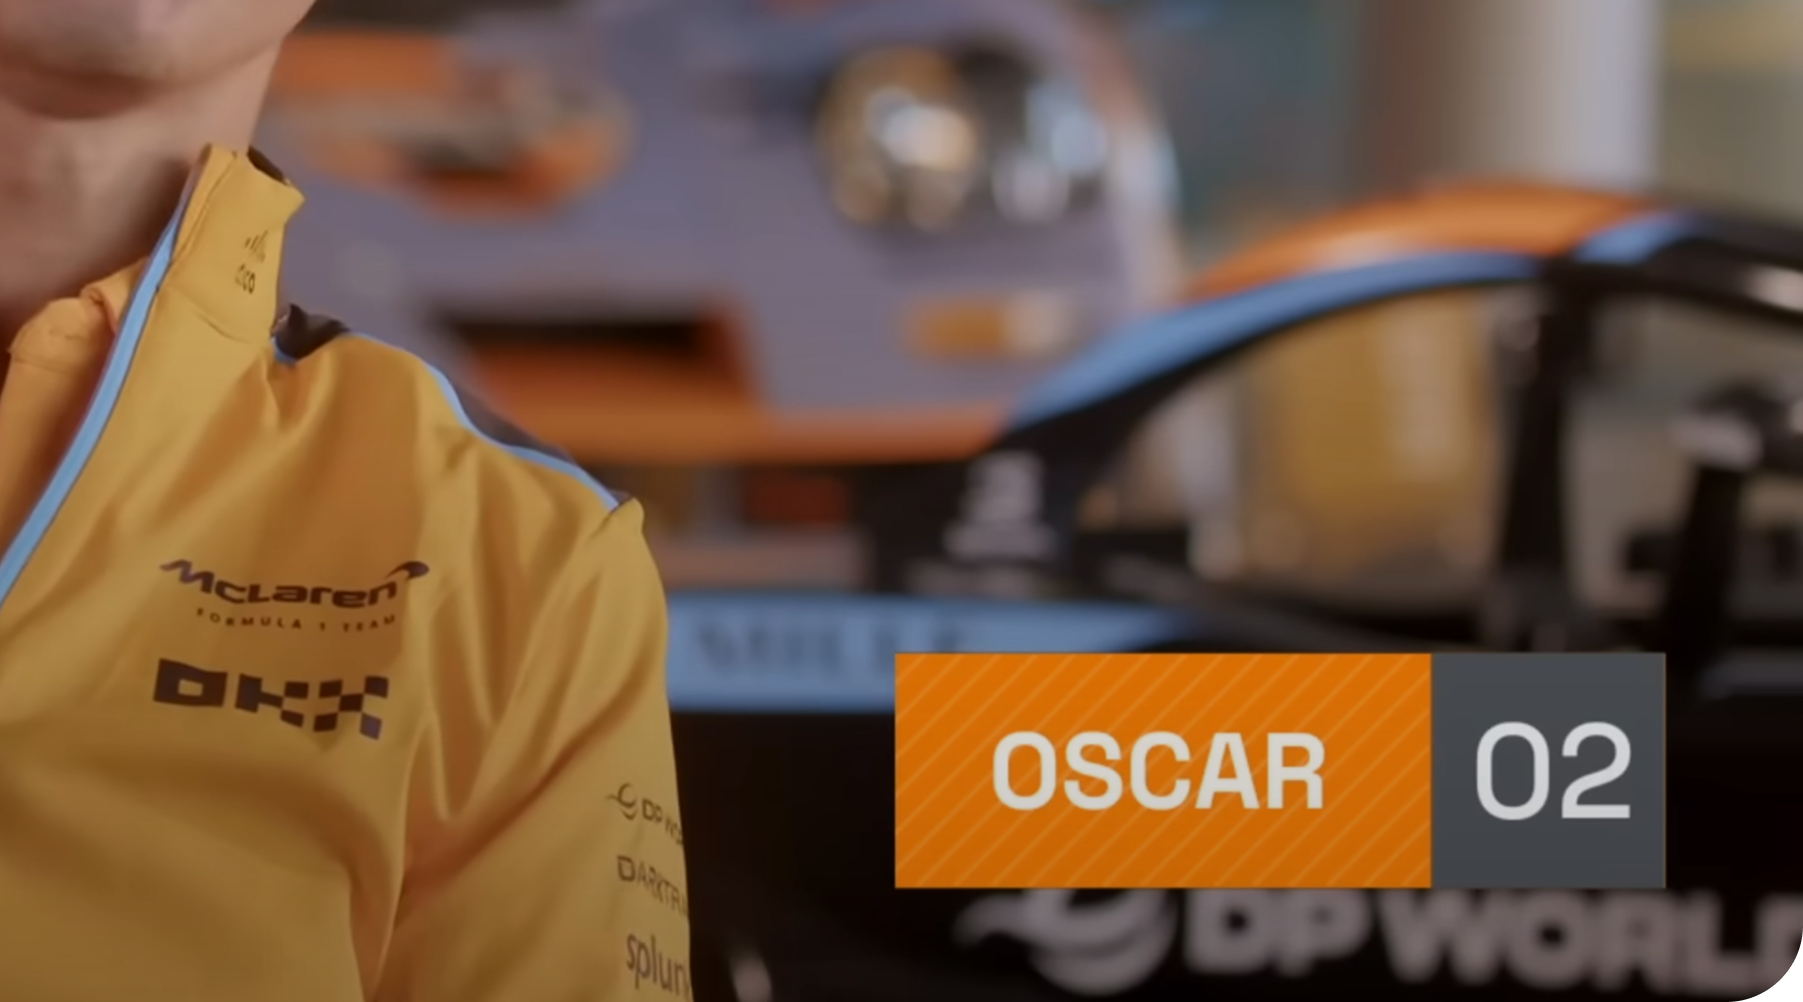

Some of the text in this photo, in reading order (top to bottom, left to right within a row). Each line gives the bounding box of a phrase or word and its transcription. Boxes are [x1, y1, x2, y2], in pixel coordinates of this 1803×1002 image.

[159, 559, 398, 608] McLaren
[197, 607, 302, 630] FORMULA
[342, 614, 396, 633] TEAM
[153, 658, 389, 740] OKX
[1184, 886, 1369, 977] DP
